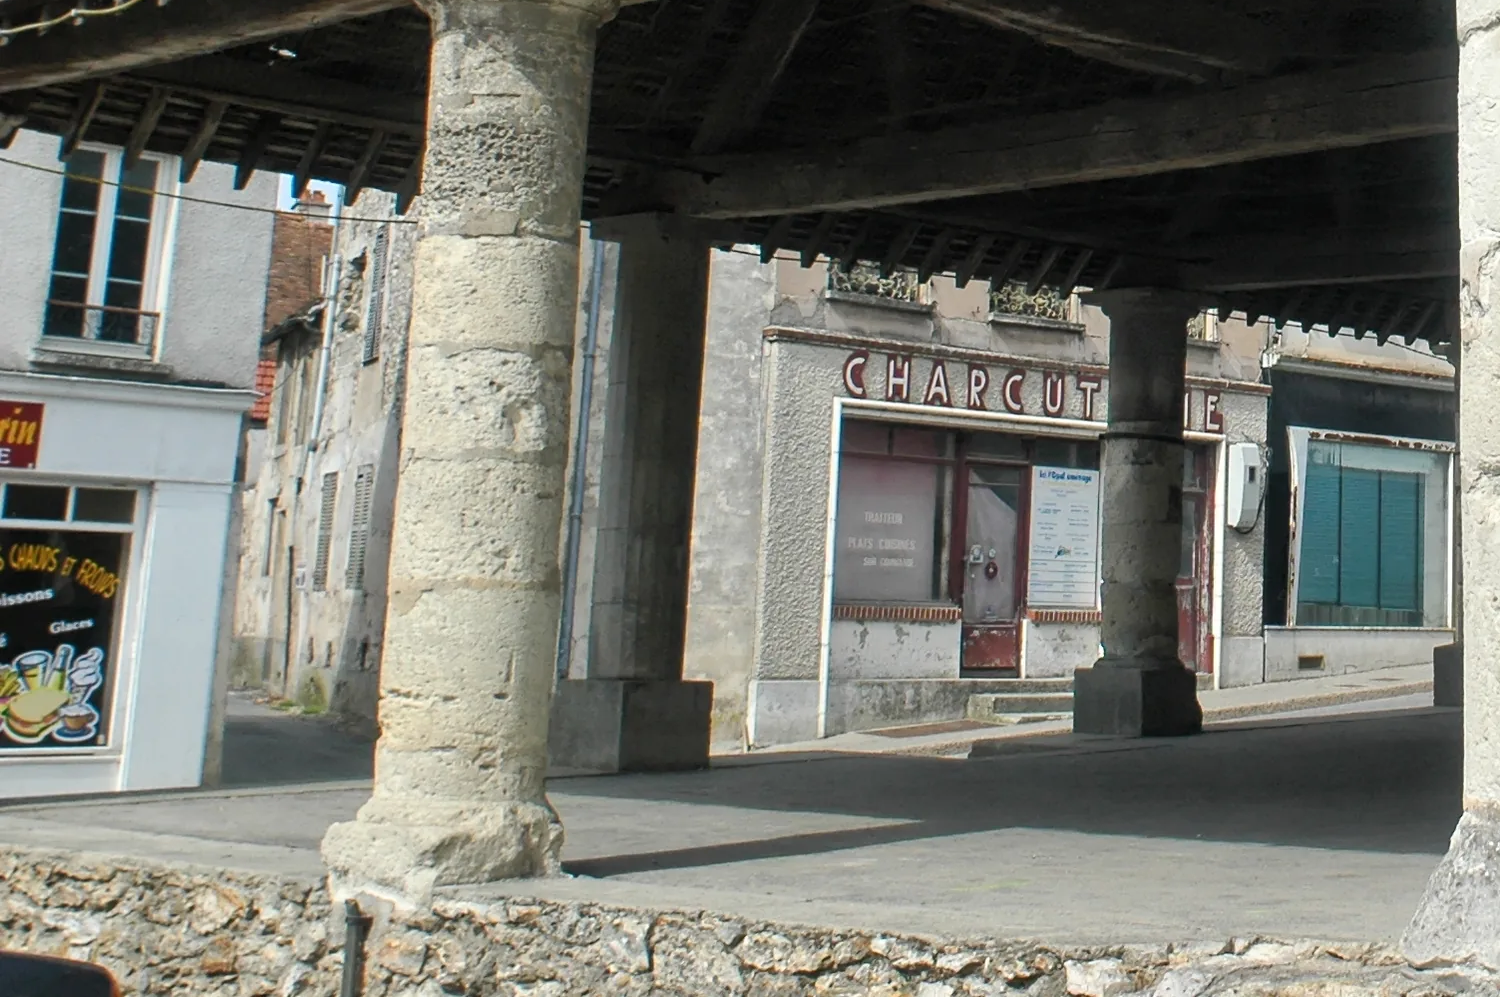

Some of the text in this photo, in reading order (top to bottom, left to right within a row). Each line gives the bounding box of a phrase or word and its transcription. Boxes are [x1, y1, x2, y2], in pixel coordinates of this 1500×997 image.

[844, 356, 1222, 432] CHARCUTIE
[9, 543, 60, 572] CHAUDS
[61, 557, 77, 576] ET
[76, 558, 120, 598] FROIDS
[0, 588, 54, 607] issons
[49, 617, 94, 634] Glaces
